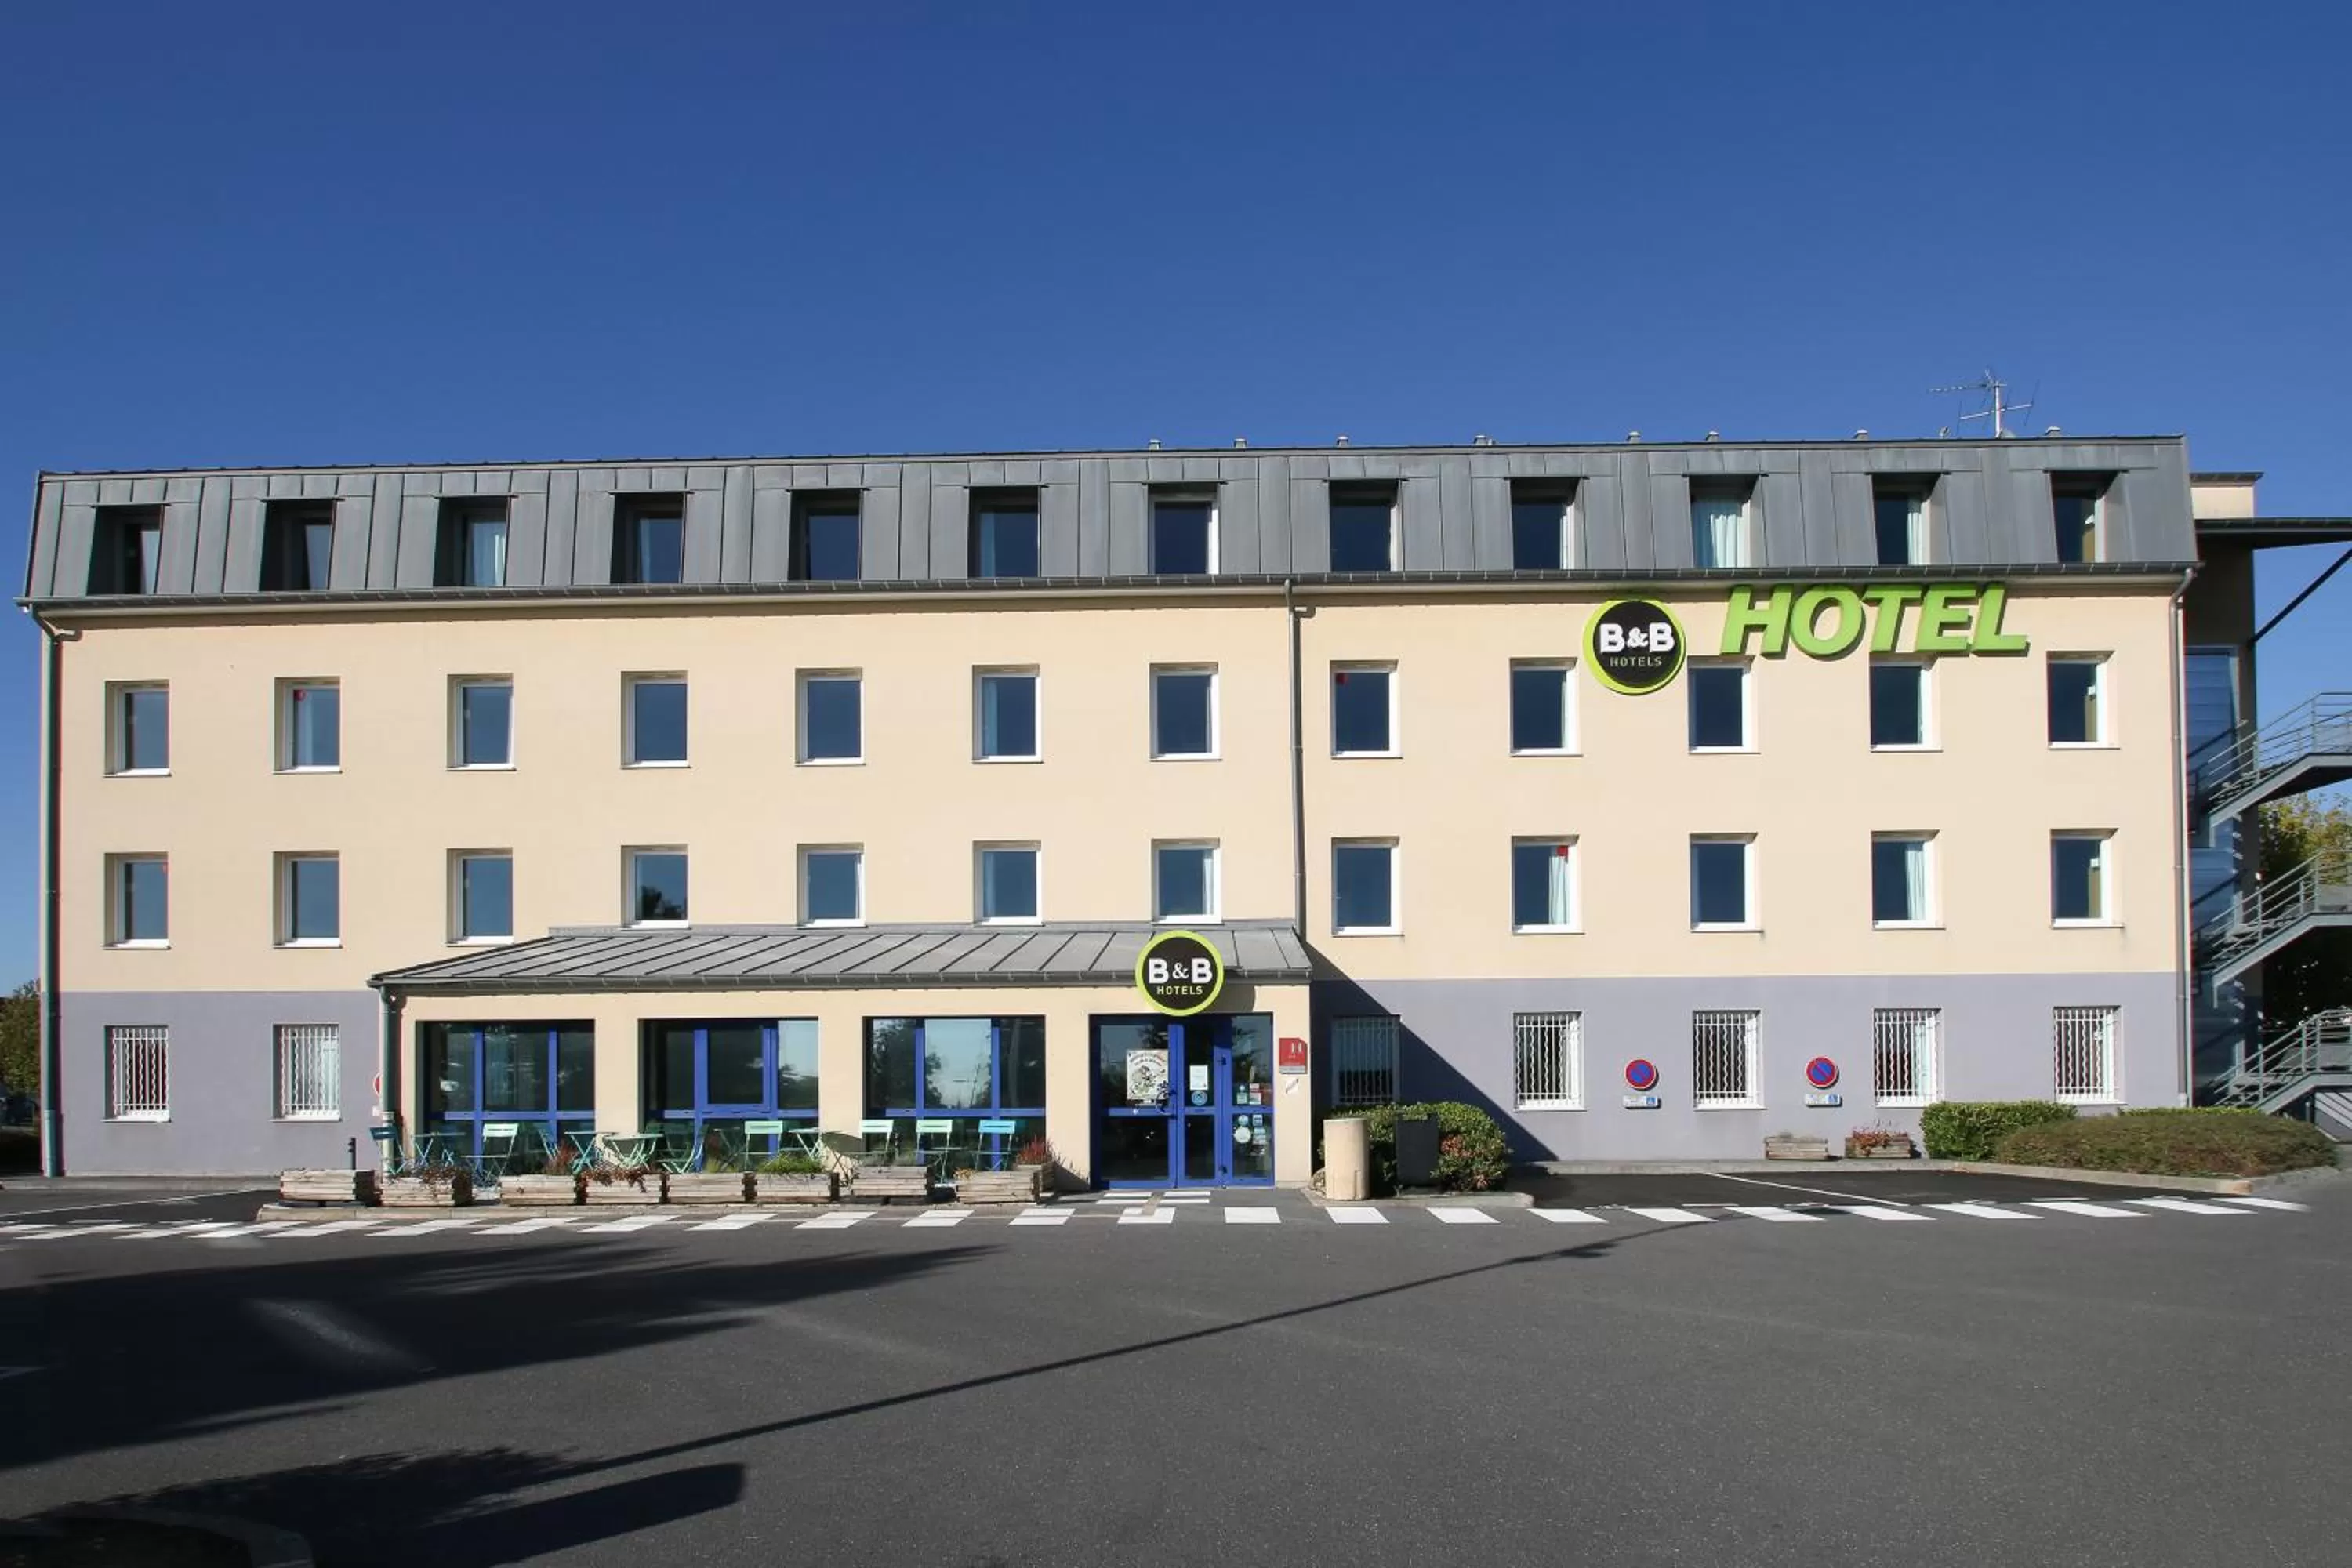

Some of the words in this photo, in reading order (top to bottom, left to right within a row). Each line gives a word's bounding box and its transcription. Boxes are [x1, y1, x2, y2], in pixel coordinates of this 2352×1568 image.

[1720, 584, 2028, 657] HOTEL
[1600, 622, 1675, 652] B&B
[1610, 656, 1662, 667] HOTELS
[1149, 958, 1213, 983] B&B
[1156, 985, 1203, 995] HOTELS
